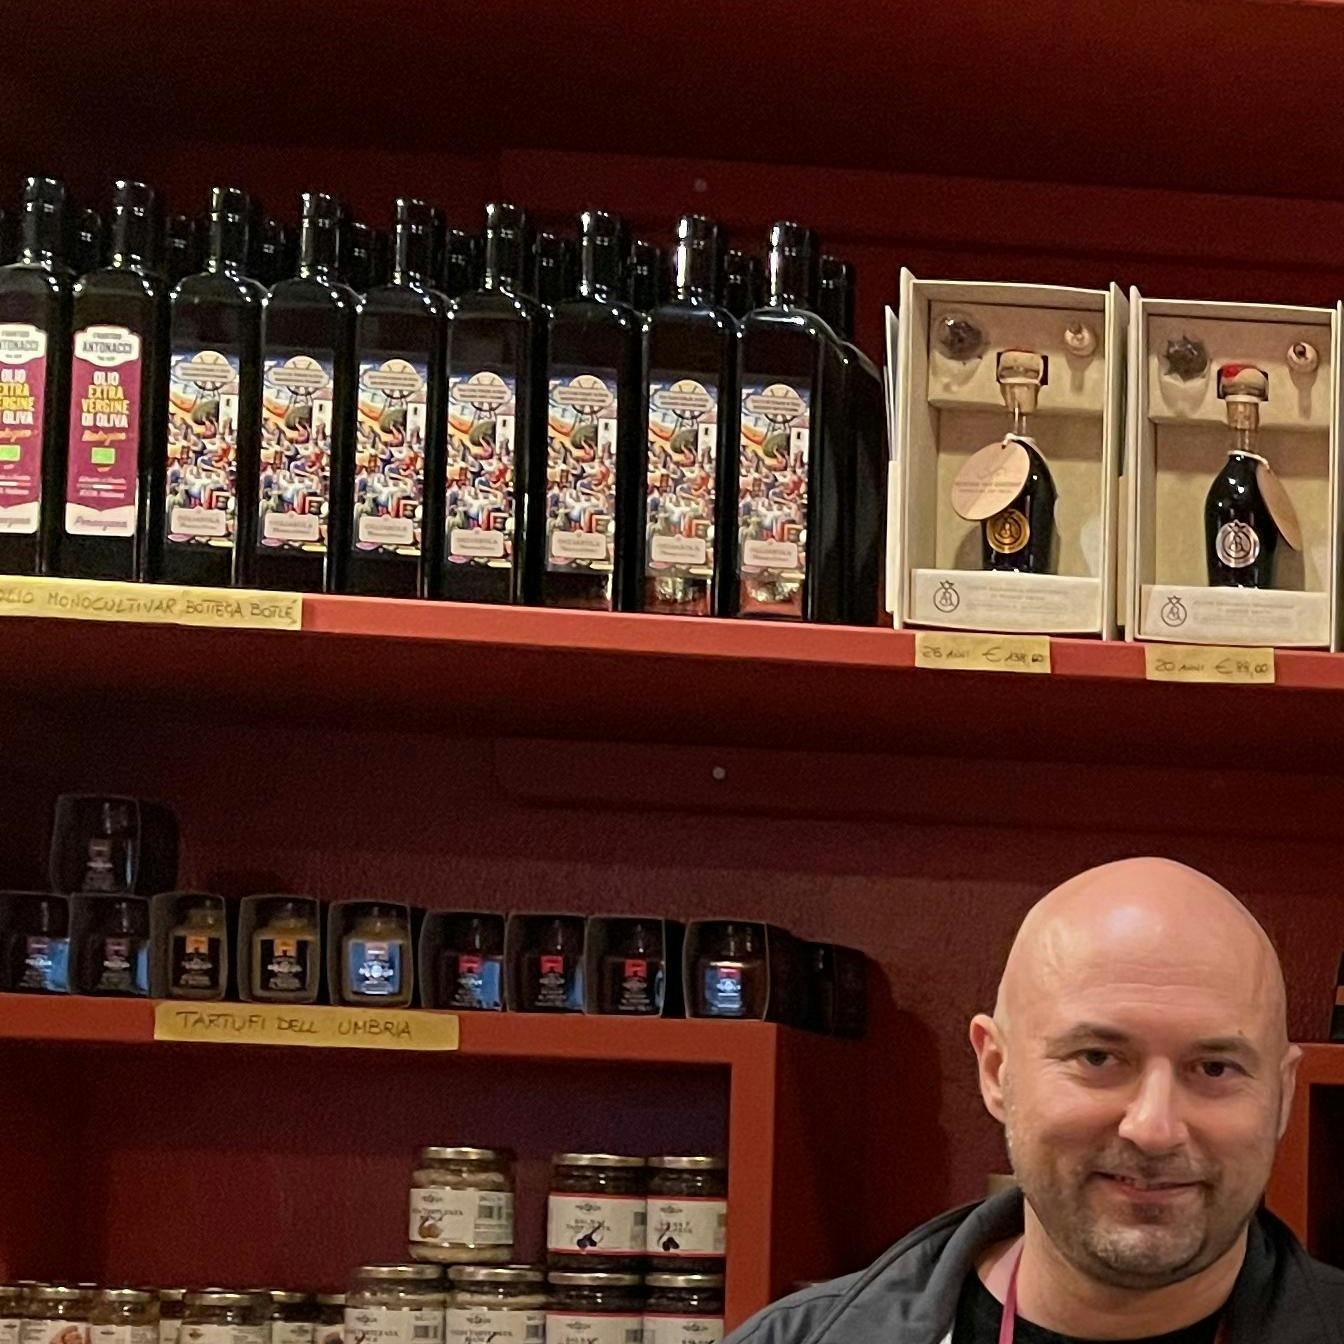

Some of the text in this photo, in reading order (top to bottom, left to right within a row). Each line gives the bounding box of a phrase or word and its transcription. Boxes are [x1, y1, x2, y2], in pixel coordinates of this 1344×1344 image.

[93, 371, 120, 385] OLIO
[0, 383, 29, 396] XTRA
[88, 385, 124, 399] EXTRA
[81, 399, 130, 414] VERGINE
[95, 414, 128, 428] OLIVA
[48, 590, 175, 615] MONOCULTIVAR
[185, 598, 244, 617] BOTTEGA
[982, 646, 1001, 662] €
[1215, 657, 1233, 675] €
[176, 1011, 265, 1031] TARTUFI
[338, 1018, 412, 1038] UMBRIA
